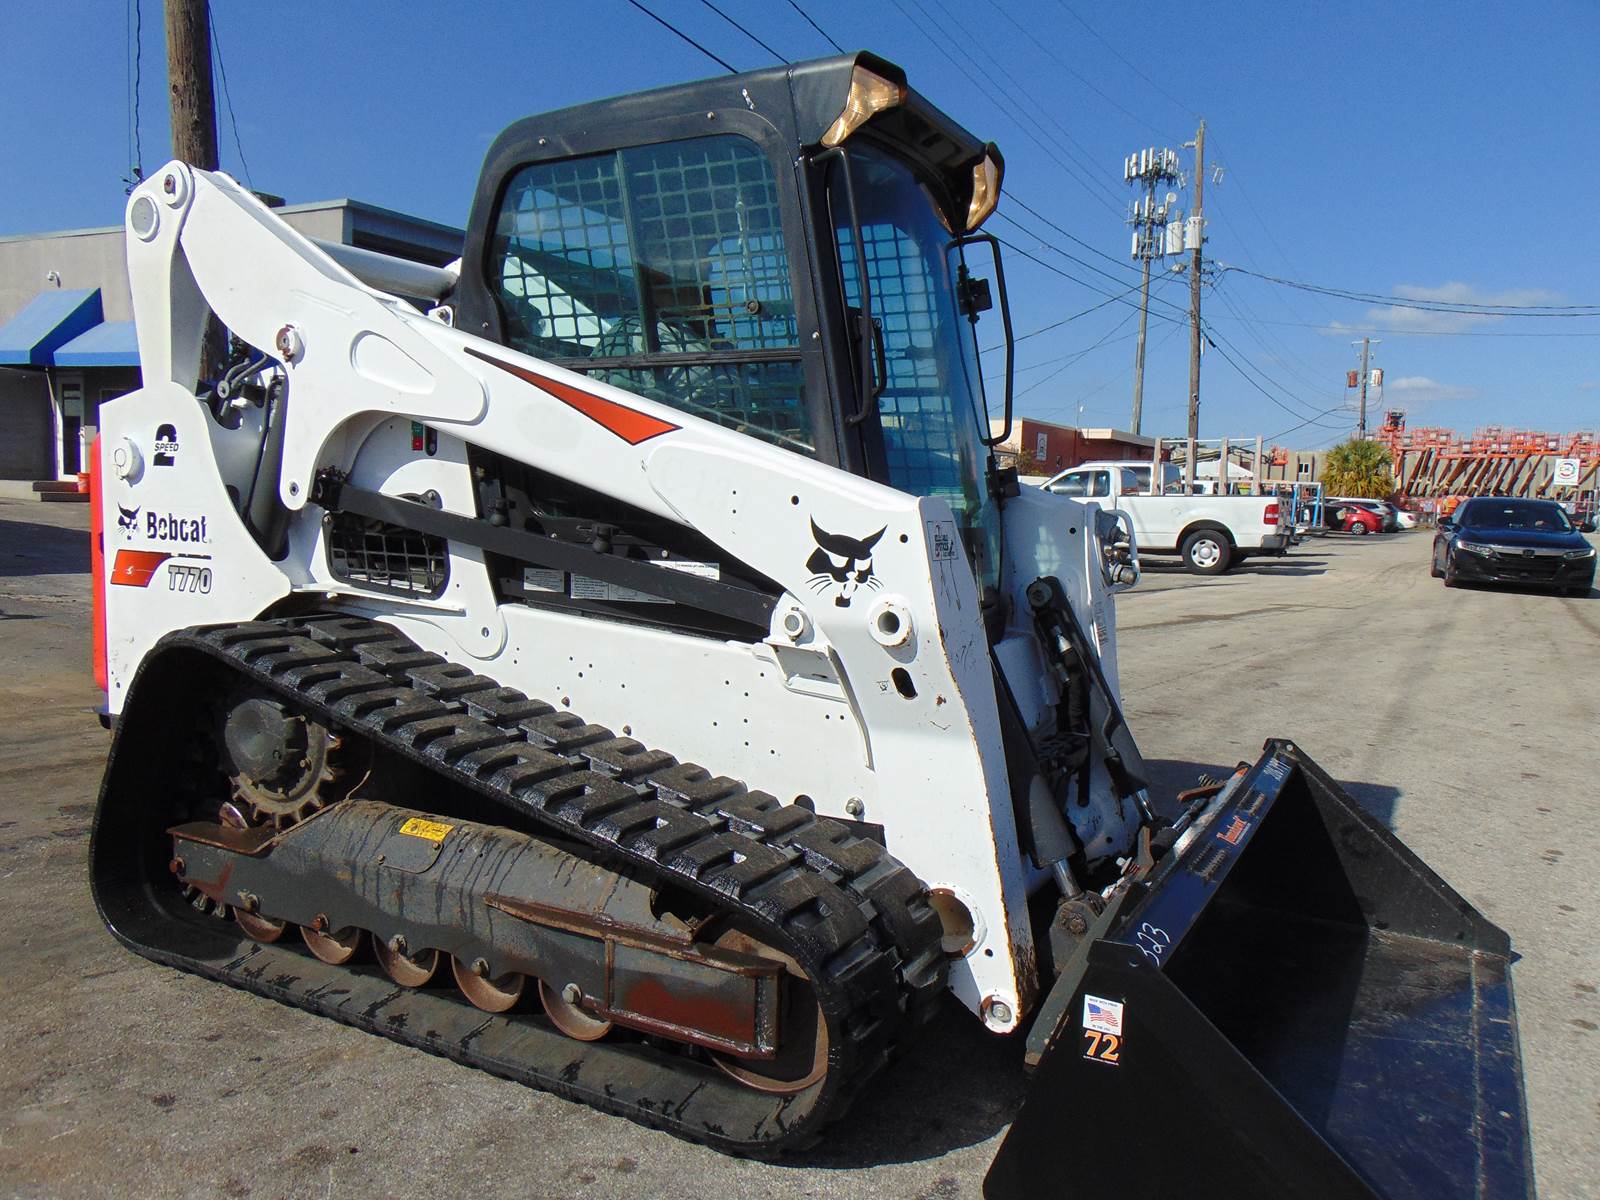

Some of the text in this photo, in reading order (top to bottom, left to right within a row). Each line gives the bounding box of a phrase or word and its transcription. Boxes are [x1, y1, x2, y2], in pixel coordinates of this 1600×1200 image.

[153, 424, 177, 466] 2
[155, 443, 179, 452] SPEED
[147, 511, 208, 543] Bobcat
[168, 564, 212, 594] T770
[1084, 1030, 1119, 1061] 72
